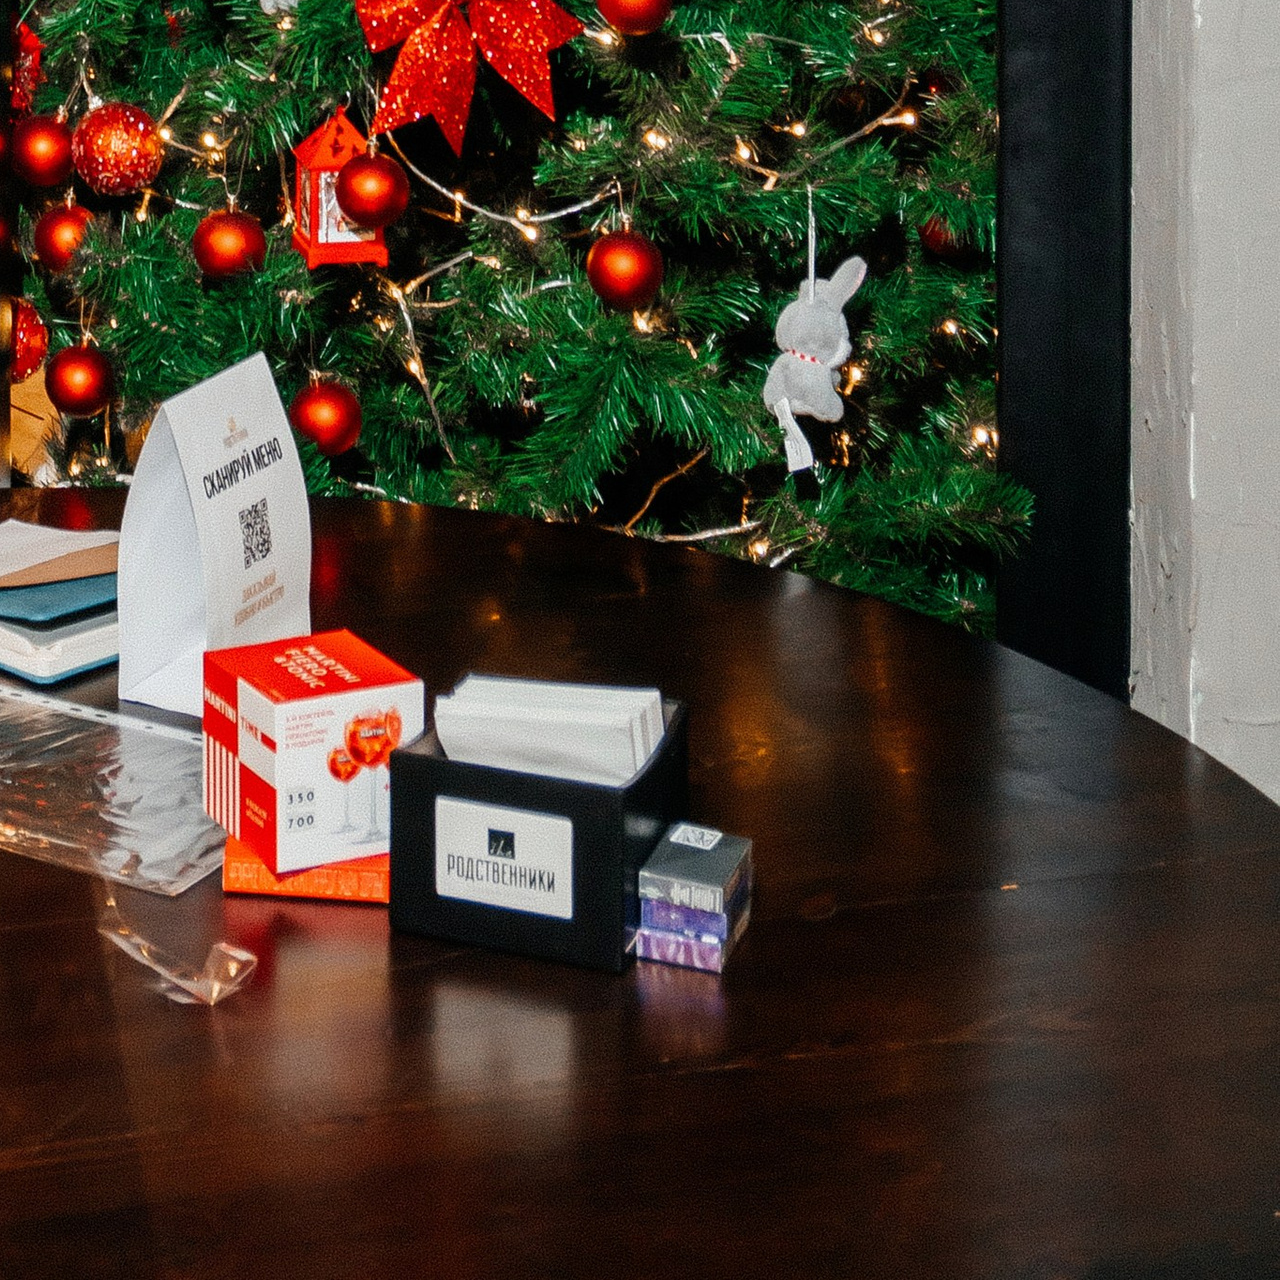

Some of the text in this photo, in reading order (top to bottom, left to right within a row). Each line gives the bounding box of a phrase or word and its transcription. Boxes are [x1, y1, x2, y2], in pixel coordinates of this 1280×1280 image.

[202, 448, 255, 500] СКАНИРУЙ
[251, 437, 283, 472] МЕНЮ
[285, 648, 328, 676] FIERO
[302, 643, 361, 683] MARTINI
[288, 815, 314, 829] 700
[447, 853, 555, 893] РОДСТВЕННИКИ
